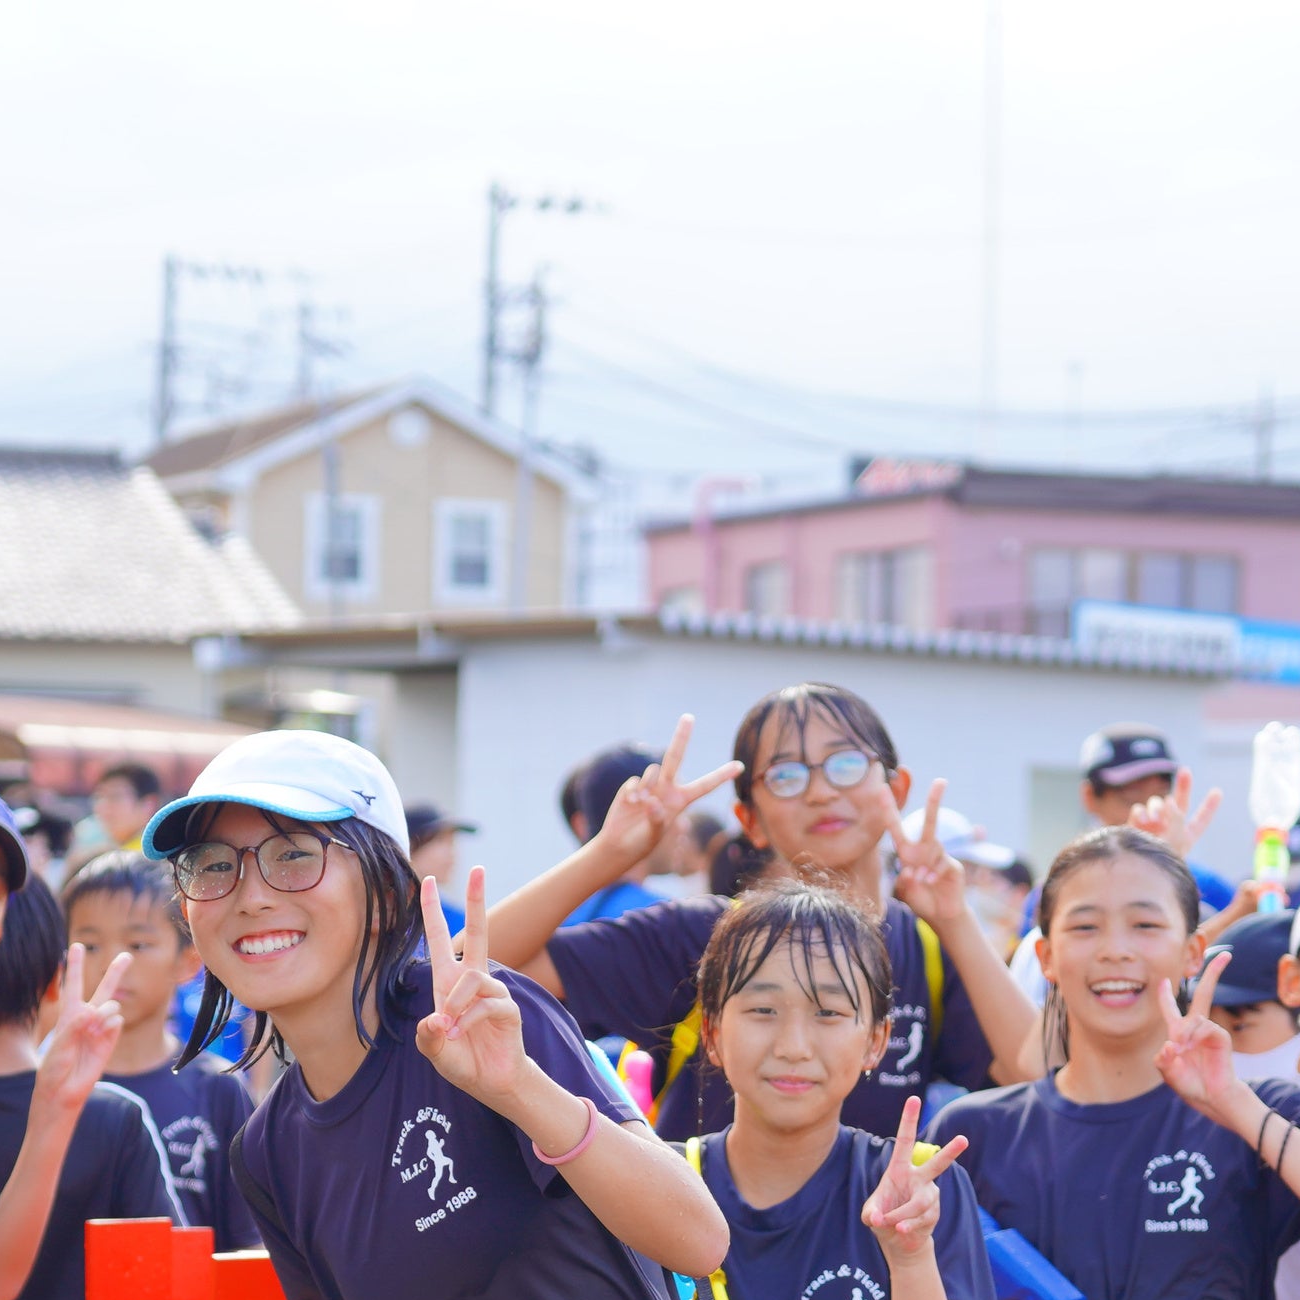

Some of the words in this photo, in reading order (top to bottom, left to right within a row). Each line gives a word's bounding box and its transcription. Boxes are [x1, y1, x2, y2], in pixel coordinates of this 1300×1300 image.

[391, 1119, 416, 1167] Track
[415, 1208, 446, 1232] Since
[445, 1186, 477, 1213] 1988
[836, 1263, 852, 1278] &
